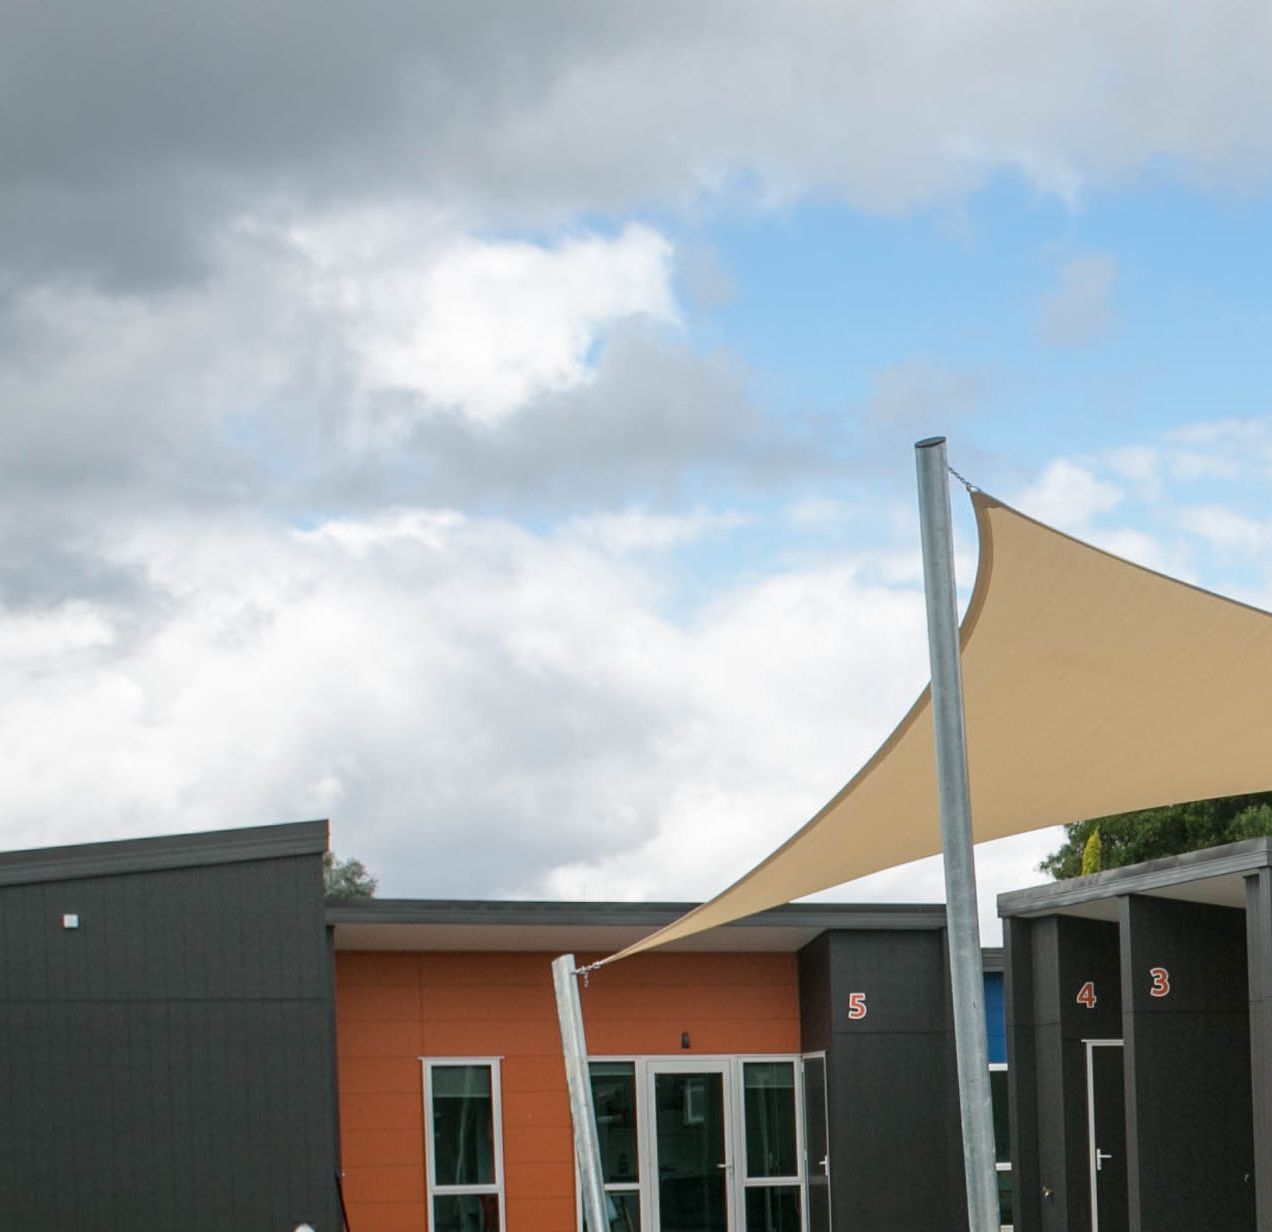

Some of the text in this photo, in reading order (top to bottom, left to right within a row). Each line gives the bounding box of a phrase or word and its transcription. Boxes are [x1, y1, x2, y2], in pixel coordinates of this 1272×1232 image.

[1076, 981, 1097, 1008] 4
[1150, 967, 1170, 997] 3
[848, 992, 867, 1019] 5
